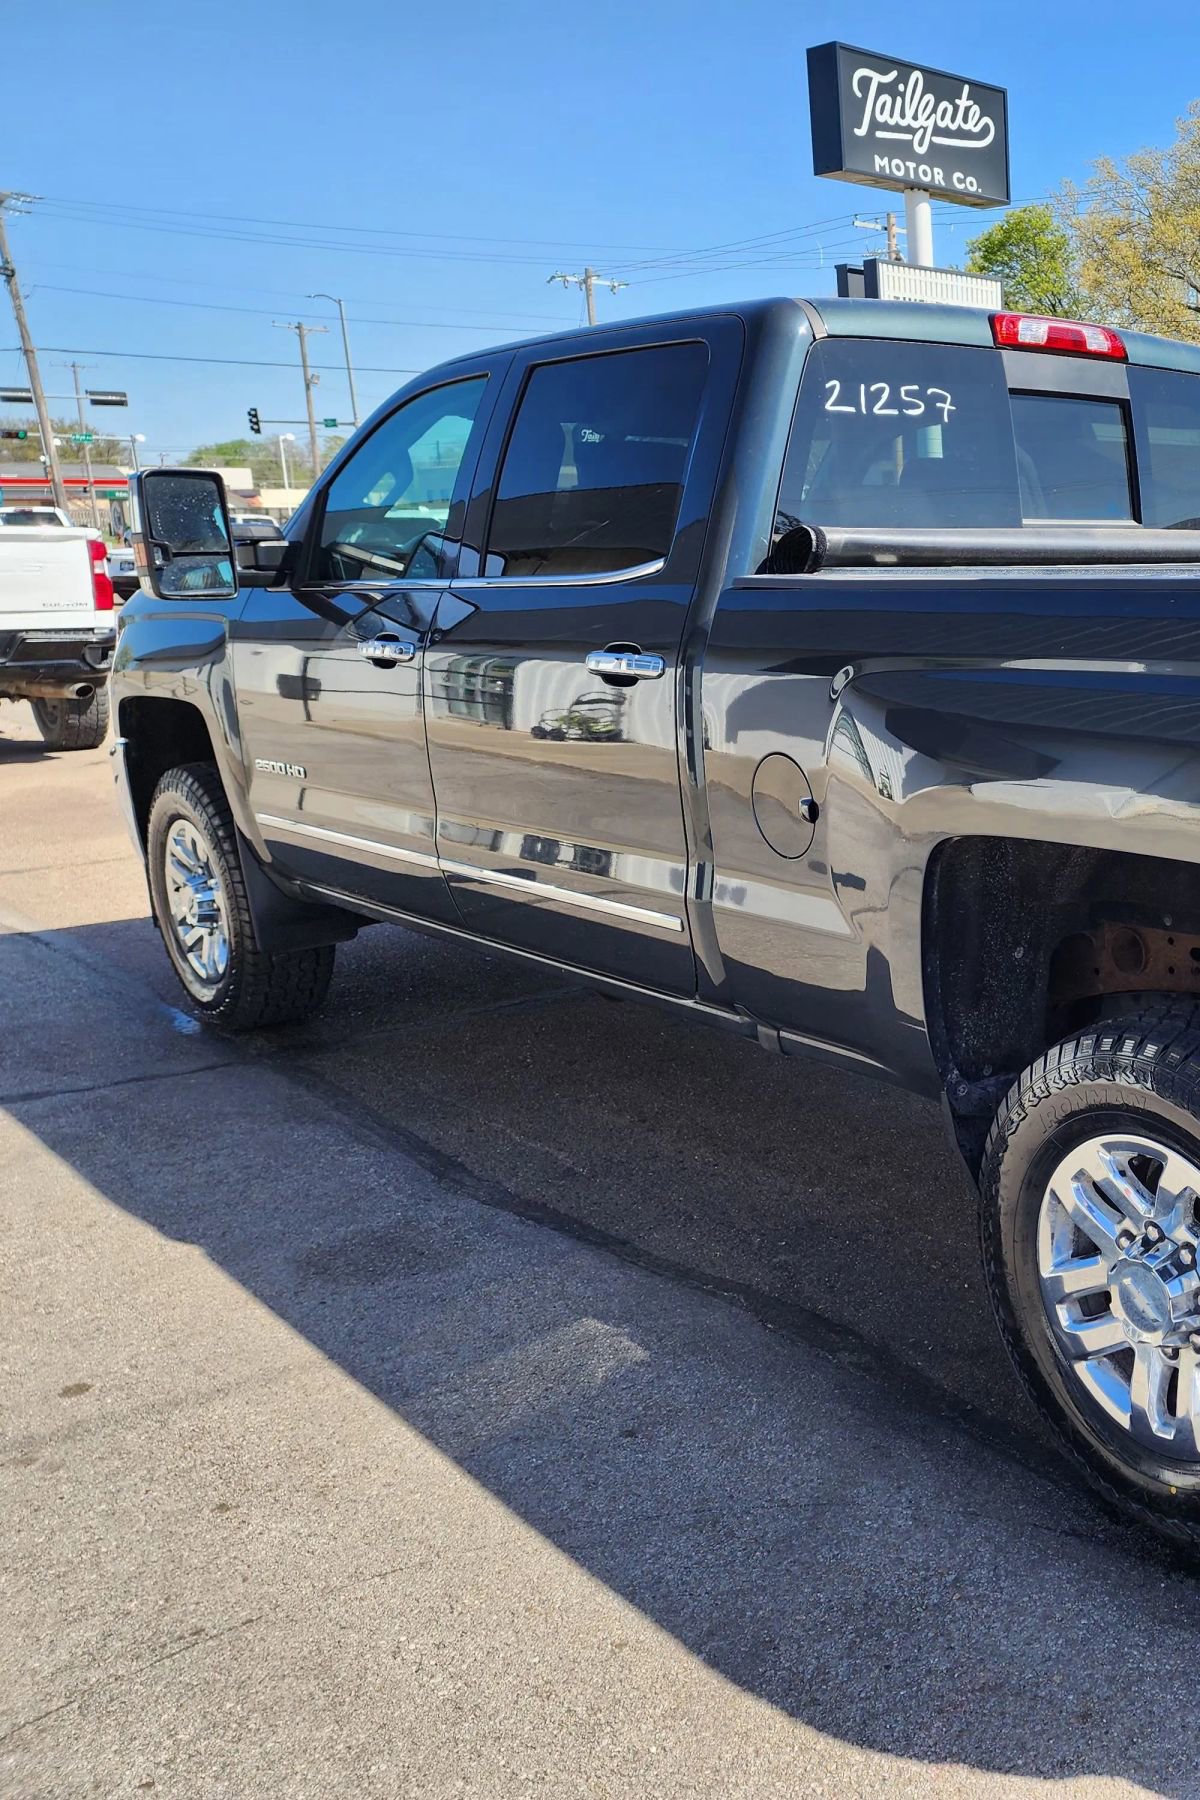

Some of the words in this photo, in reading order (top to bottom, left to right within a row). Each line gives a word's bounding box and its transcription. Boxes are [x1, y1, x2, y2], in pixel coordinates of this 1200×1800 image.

[852, 68, 995, 154] Tailgate
[874, 154, 946, 186] MOTOR
[952, 172, 982, 193] CO.
[825, 380, 957, 423] 21257
[255, 758, 286, 775] 2500
[286, 763, 307, 779] HD
[1039, 1088, 1147, 1134] IRONMAN
